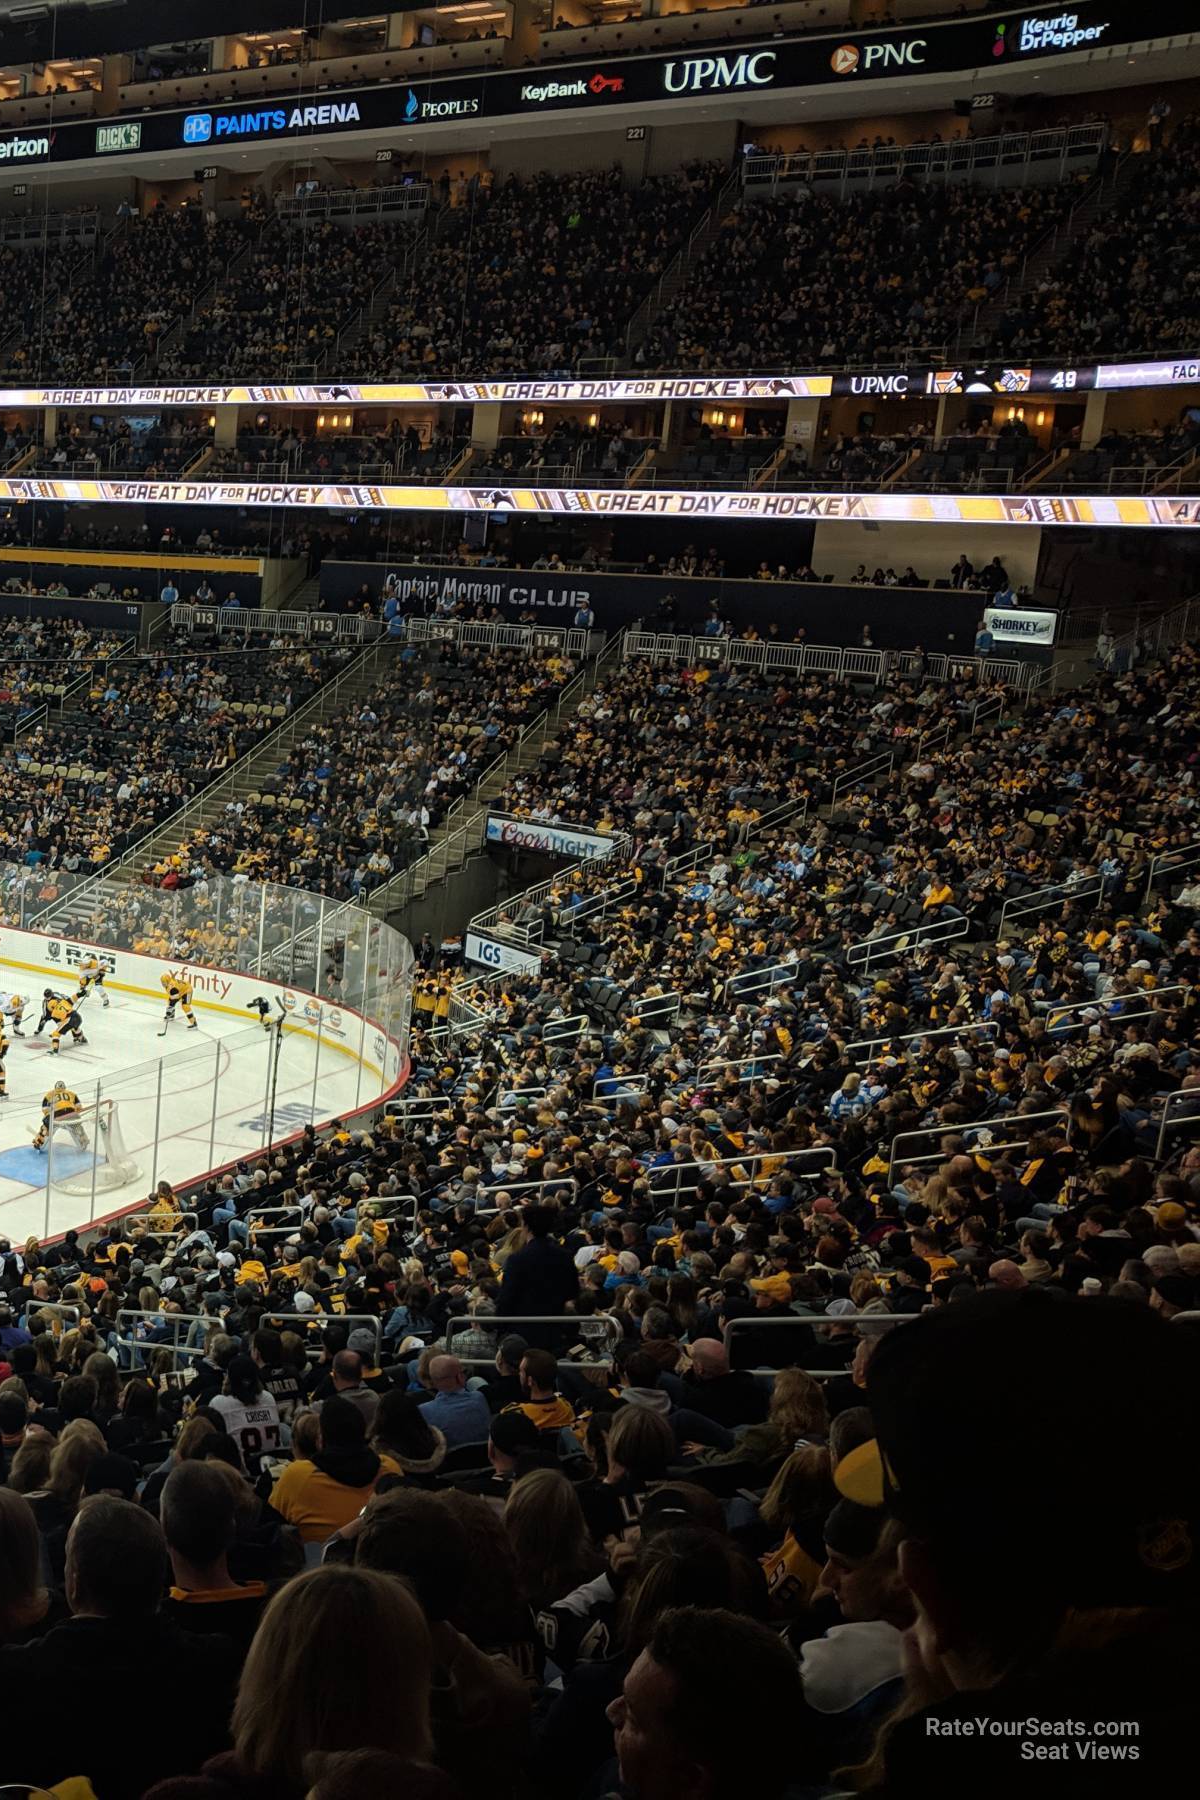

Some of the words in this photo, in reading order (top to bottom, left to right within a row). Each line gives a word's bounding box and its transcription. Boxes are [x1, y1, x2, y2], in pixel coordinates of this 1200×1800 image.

[1022, 13, 1078, 35] Keurig
[1020, 24, 1105, 51] DrPepper
[864, 40, 926, 69] PNC
[664, 52, 776, 92] UPMC
[521, 80, 587, 101] KeyBank
[421, 99, 479, 118] PEOPLES
[973, 95, 994, 108] 222
[184, 114, 211, 141] PPG
[216, 110, 286, 135] PAINTS
[288, 102, 360, 128] ARENA
[98, 124, 139, 148] DICK'S
[627, 128, 644, 139] 221
[377, 151, 391, 161] 220
[204, 168, 217, 179] 219
[502, 382, 579, 399] GREAT
[578, 381, 622, 398] DAY
[624, 382, 656, 395] FOR
[657, 379, 758, 397] HOCKEY
[851, 376, 908, 394] UPMC
[51, 391, 103, 405] GREAT
[106, 390, 135, 405] DAY
[138, 390, 161, 401] FOR
[162, 388, 233, 404] HOCKEY
[113, 486, 124, 497] A
[125, 486, 182, 501] GREAT
[184, 486, 219, 502] DAY
[219, 488, 244, 499] FOR
[246, 487, 322, 504] HOCKEY
[597, 493, 674, 512] GREAT
[678, 495, 724, 514] DAY
[727, 497, 761, 511] FOR
[762, 495, 866, 517] HOCKEY
[386, 573, 440, 604] Captain
[442, 576, 502, 605] Morgan
[509, 587, 590, 608] CLUB
[126, 606, 138, 615] 112
[195, 611, 214, 625] 113
[313, 619, 334, 632] 113
[992, 618, 1039, 632] SHORKEY
[536, 633, 559, 648] 114
[699, 645, 720, 661] 115
[501, 821, 551, 851] Coors
[551, 833, 598, 857] LIGHT
[478, 941, 502, 965] IGS
[169, 967, 232, 1000] xfinity
[55, 1092, 71, 1102] 30
[245, 1410, 271, 1423] CROSBY
